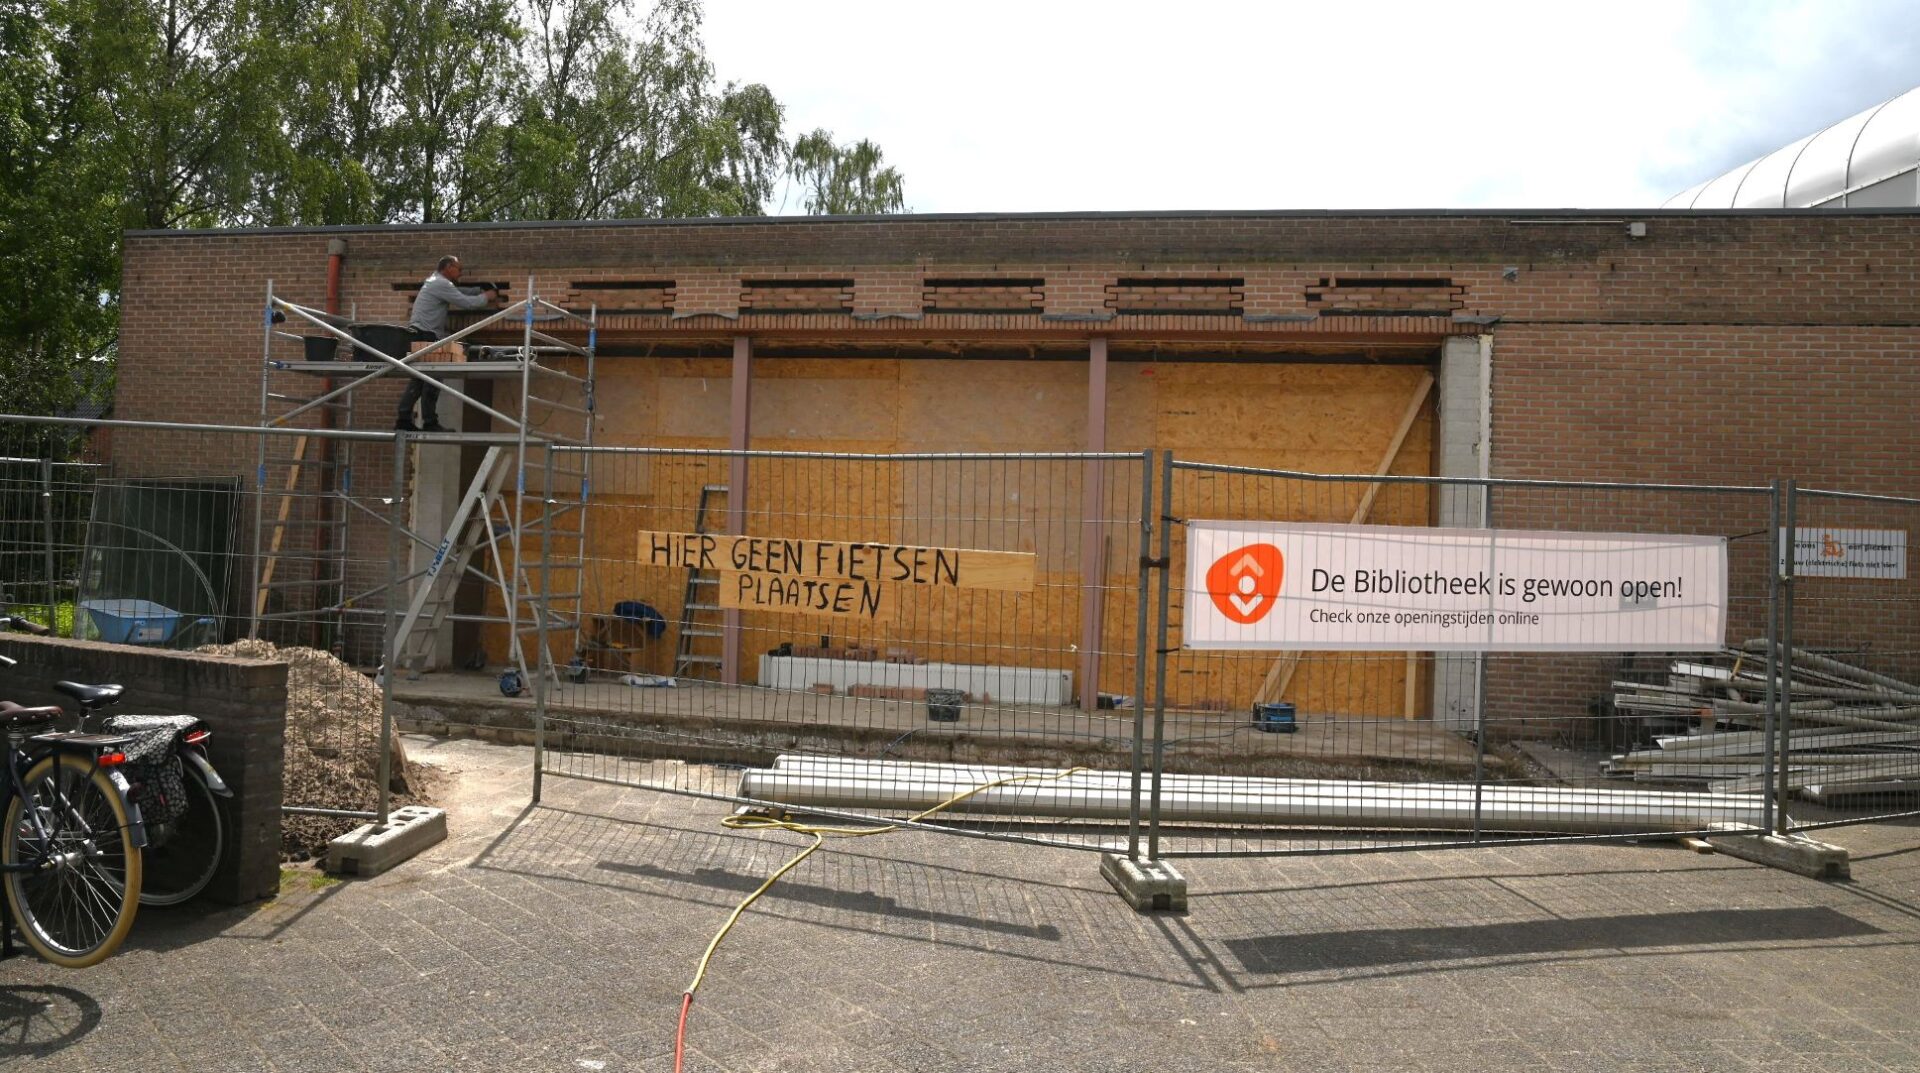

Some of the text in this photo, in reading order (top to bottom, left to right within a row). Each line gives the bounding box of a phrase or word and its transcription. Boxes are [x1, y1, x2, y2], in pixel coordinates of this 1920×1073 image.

[731, 538, 802, 574] GEEN
[815, 542, 959, 586] FIETSEN
[738, 574, 881, 619] PLAATSEN
[1311, 568, 1682, 604] De Bibliotheek is gewoon open!
[1309, 609, 1540, 628] Check onze openingstijden online
